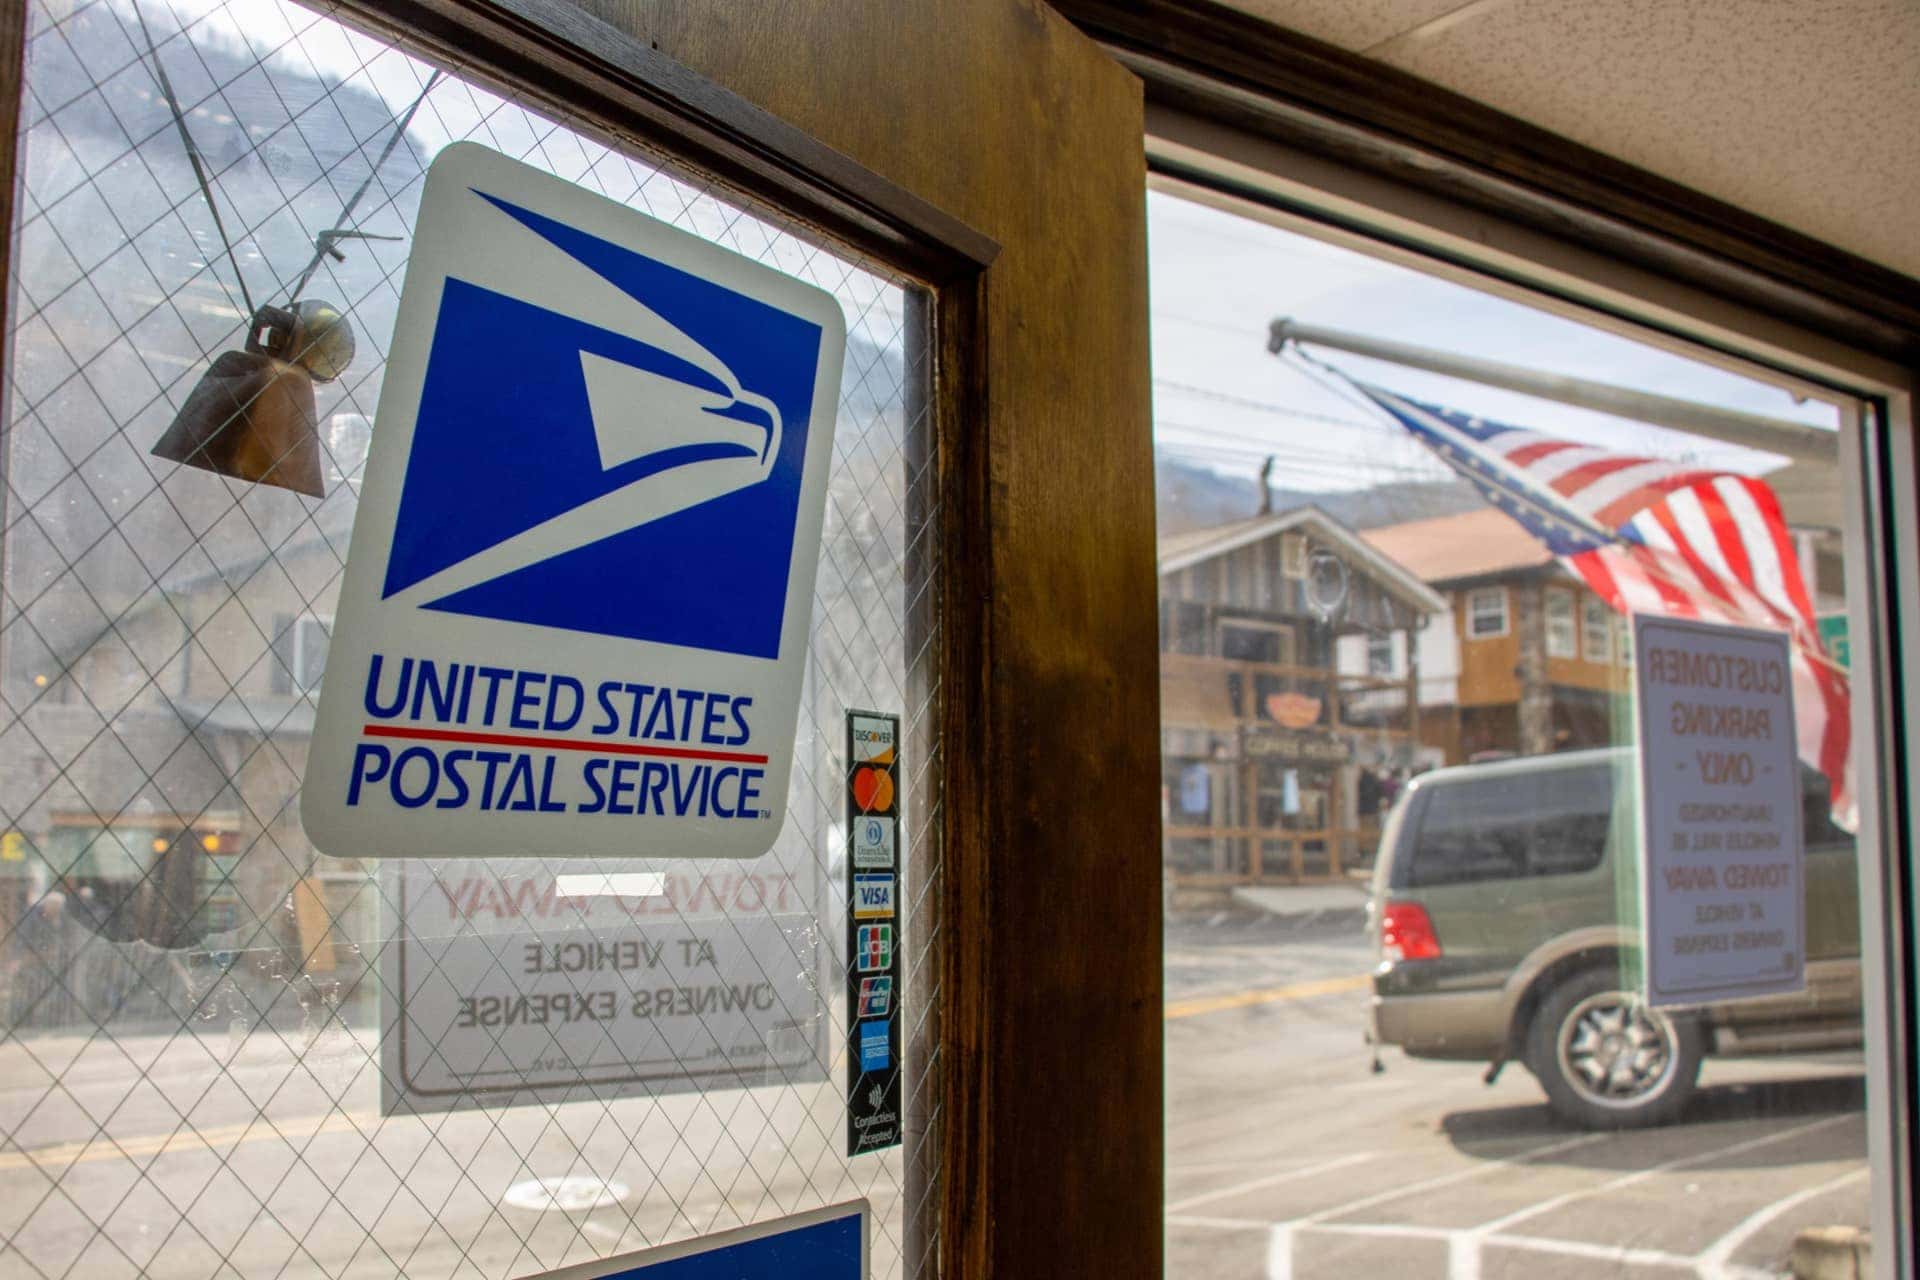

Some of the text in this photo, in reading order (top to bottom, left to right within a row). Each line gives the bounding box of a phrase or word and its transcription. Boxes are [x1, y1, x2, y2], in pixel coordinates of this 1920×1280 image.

[364, 654, 752, 746] UNITED STATES
[346, 743, 566, 812] POSTAL
[578, 758, 765, 819] SERVICE
[860, 887, 889, 905] VISA
